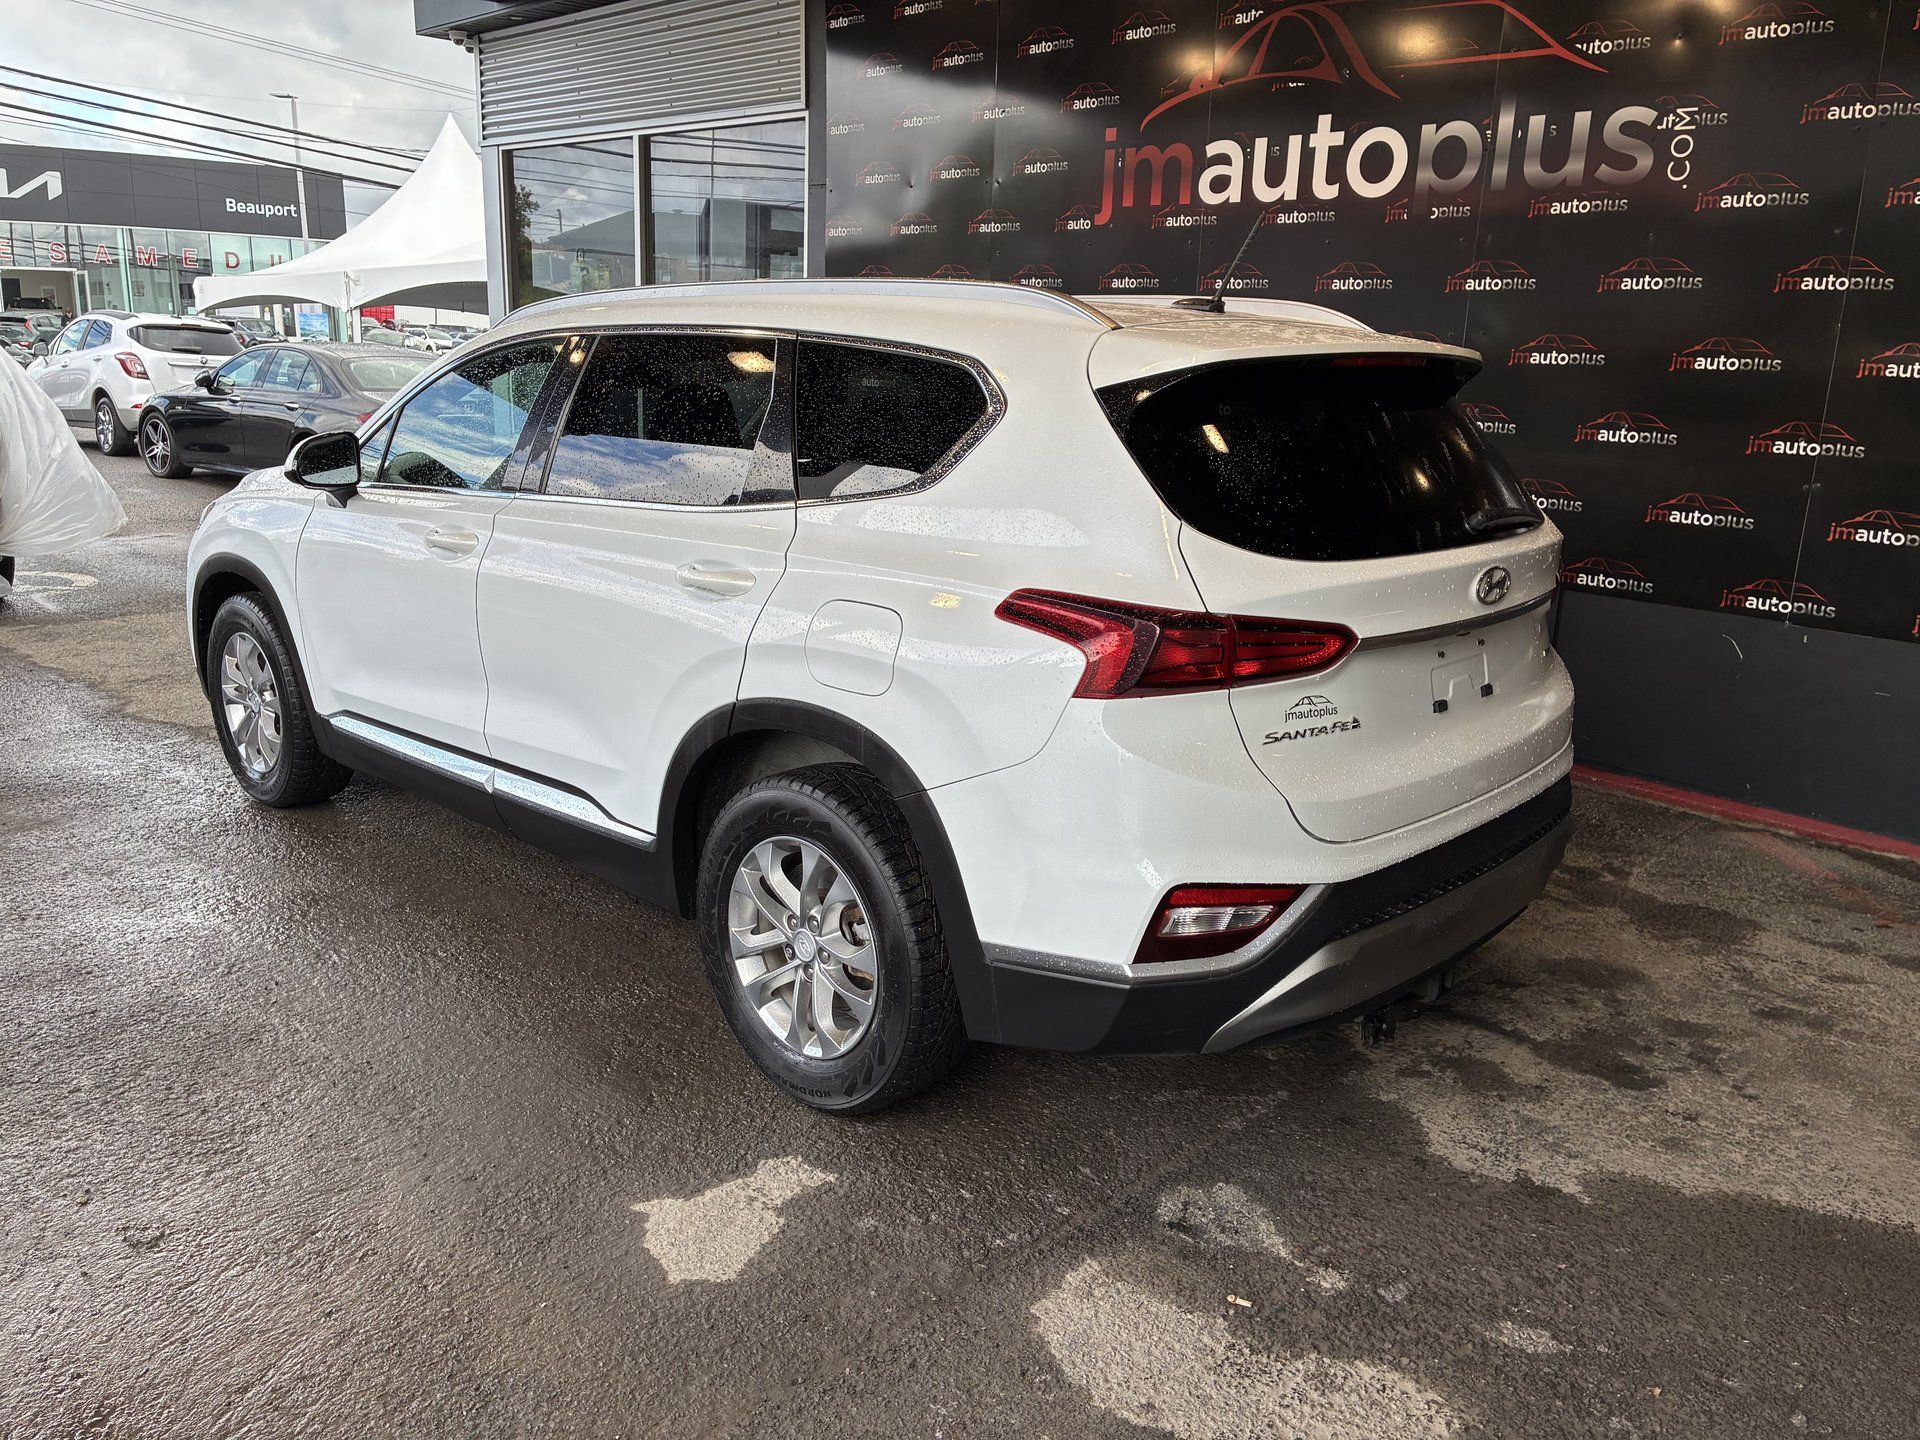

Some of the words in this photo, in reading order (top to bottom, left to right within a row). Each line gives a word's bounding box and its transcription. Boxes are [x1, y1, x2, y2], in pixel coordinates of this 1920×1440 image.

[1111, 23, 1177, 45] jmautoplus
[1718, 18, 1835, 46] jmautoplus
[1017, 37, 1074, 59] jmautoplus
[932, 52, 984, 71] jmautoplus
[971, 104, 1025, 123] jmautoplus
[1060, 94, 1120, 113] jmautoplus
[1012, 160, 1069, 176] jmautoplus
[1094, 96, 1659, 226] jmautoplus
[929, 167, 980, 182] jmautoplus
[225, 197, 298, 218] Beauport
[1528, 197, 1629, 218] jmautoplus
[1694, 191, 1809, 212] jmautoplus
[1151, 213, 1218, 229] jmautoplus
[1261, 207, 1336, 227] jmautoplus
[890, 223, 938, 237] jmautoplus
[968, 220, 1021, 235] jmautoplus
[1098, 276, 1160, 290] jmautoplus
[1315, 276, 1393, 291] jmautoplus
[1444, 275, 1537, 293] jmautoplus
[1597, 274, 1703, 293] jmautoplus
[1773, 273, 1895, 293] jmautoplus
[1508, 348, 1606, 366] jmautoplus
[1669, 352, 1782, 372] jmautoplus
[1574, 424, 1678, 446] jmautoplus
[1746, 435, 1865, 459] jmautoplus
[1644, 504, 1755, 531] jmautoplus
[1561, 571, 1654, 594] mautoplus
[1720, 588, 1836, 619] jmautoplus
[1284, 705, 1338, 723] jmautoplus
[1262, 725, 1329, 746] SANTA
